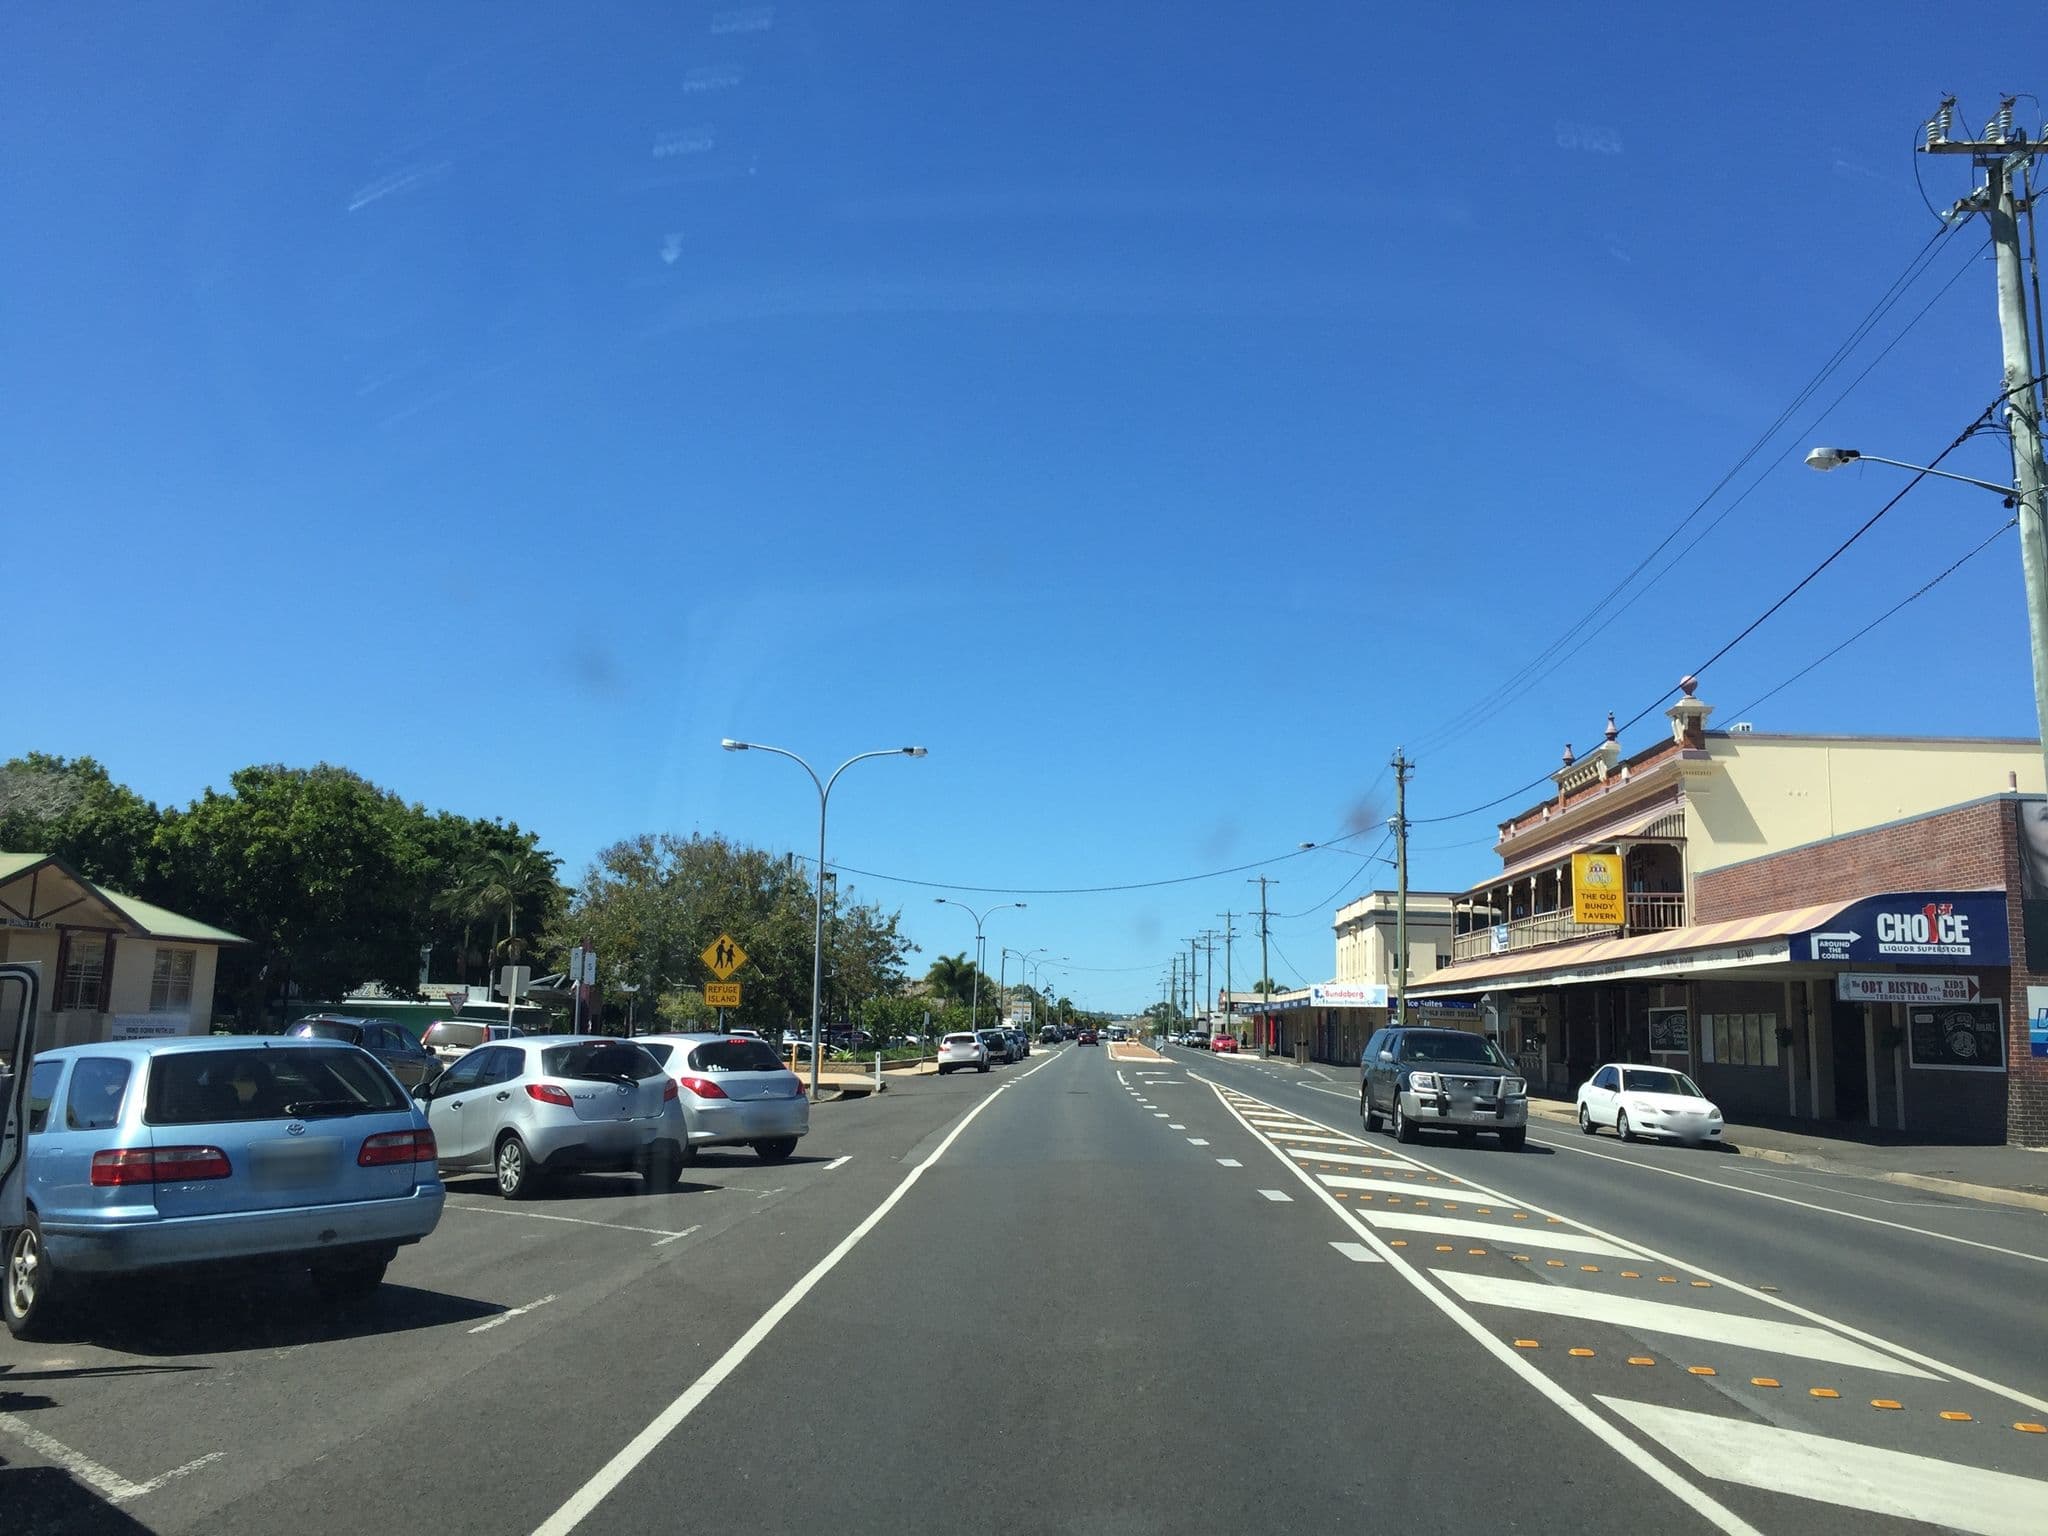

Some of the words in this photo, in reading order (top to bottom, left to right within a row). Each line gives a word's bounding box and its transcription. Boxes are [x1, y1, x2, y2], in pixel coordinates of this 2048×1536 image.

[1585, 902, 1615, 910] BUNDY
[1582, 912, 1617, 920] TAVERN
[1883, 944, 1915, 953] LIQUOR
[1917, 945, 1966, 953] SUPERSTORE
[1861, 980, 1883, 994] OBT
[1888, 981, 1928, 994] BISTRO
[1944, 980, 1964, 989] KIDS
[708, 985, 738, 994] REFUGE
[1942, 989, 1967, 998] ROOM
[708, 995, 737, 1003] ISLAND
